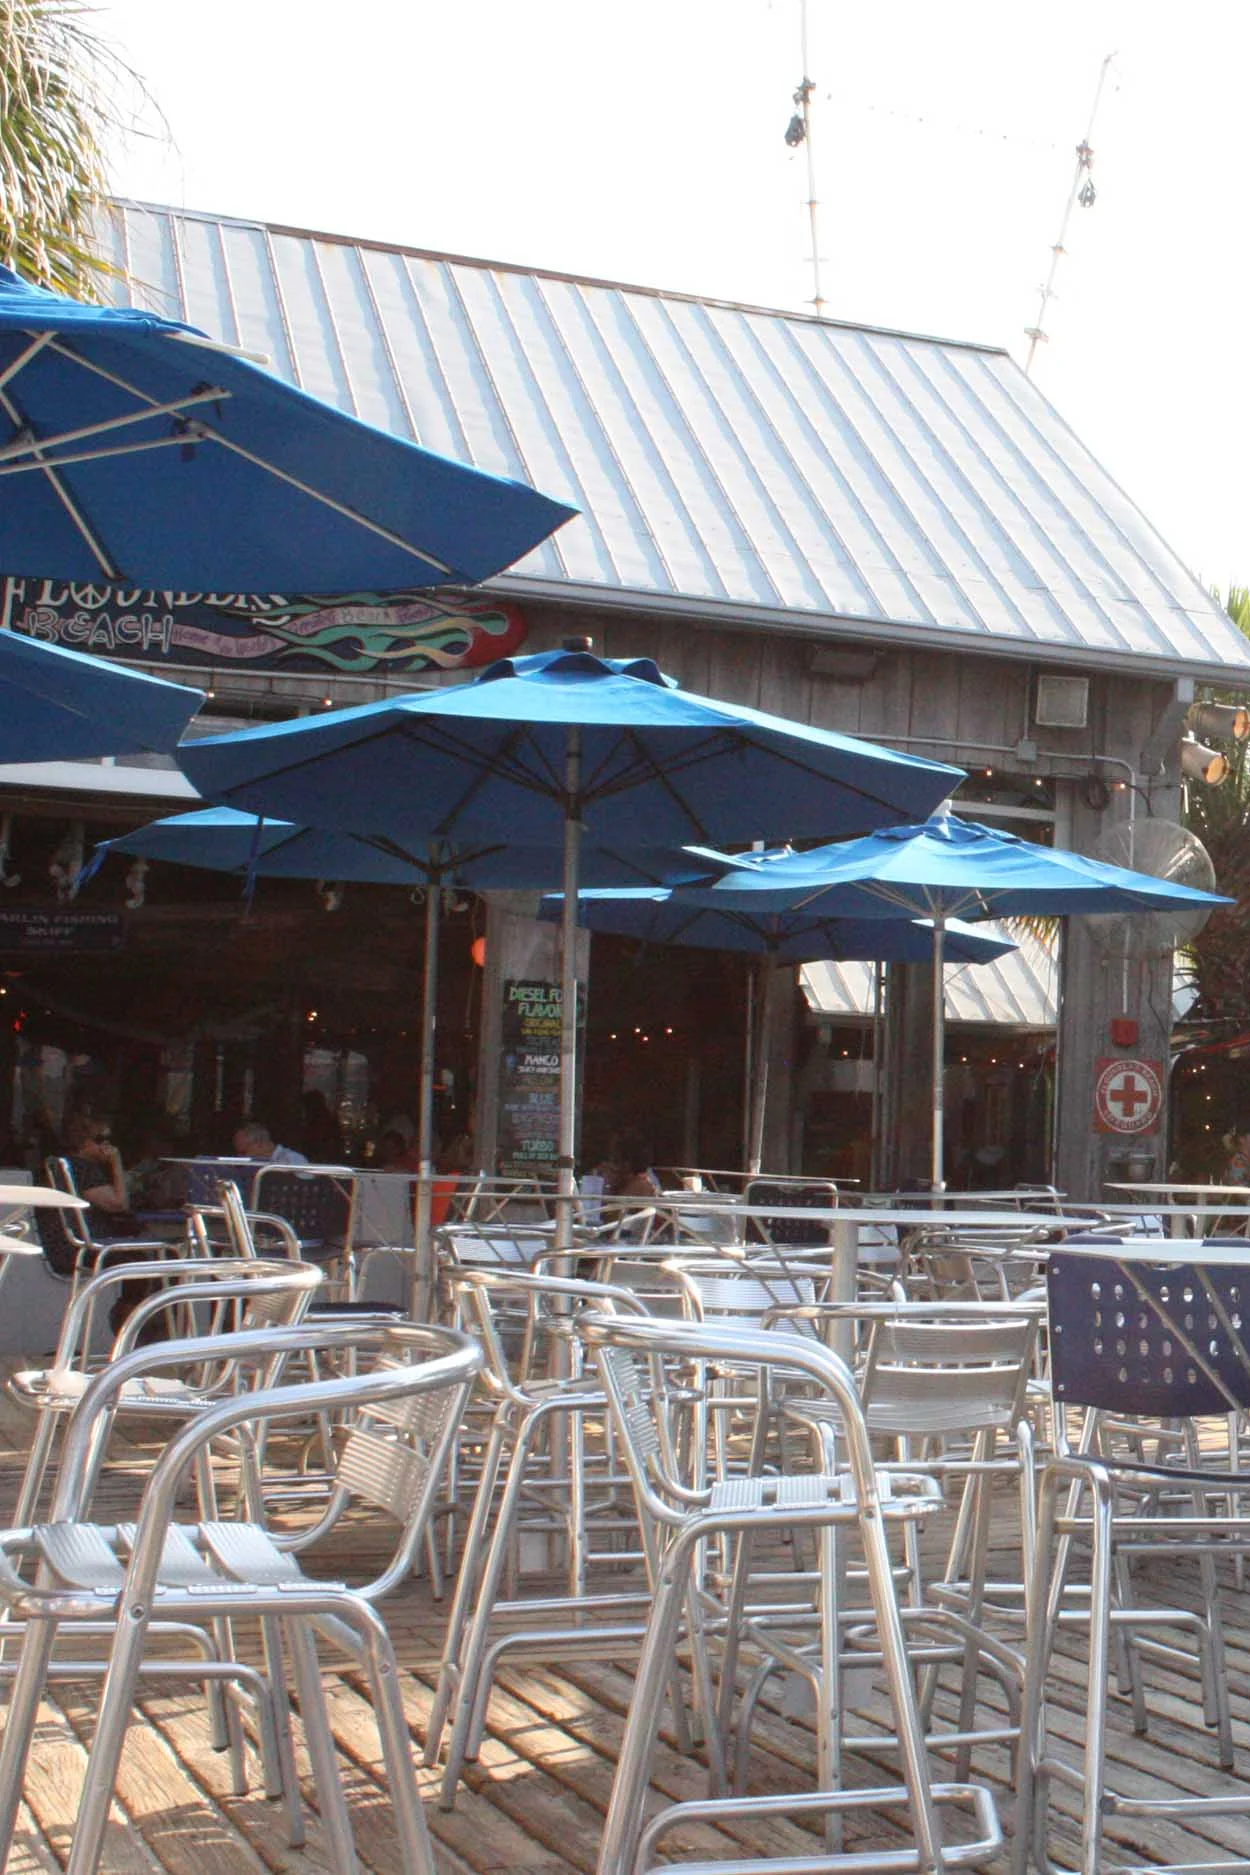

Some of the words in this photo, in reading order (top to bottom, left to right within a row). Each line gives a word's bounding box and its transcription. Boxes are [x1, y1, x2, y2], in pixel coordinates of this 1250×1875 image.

[25, 607, 174, 654] BEACH
[510, 986, 547, 1002] DIESEL
[517, 1003, 563, 1018] FLAVO
